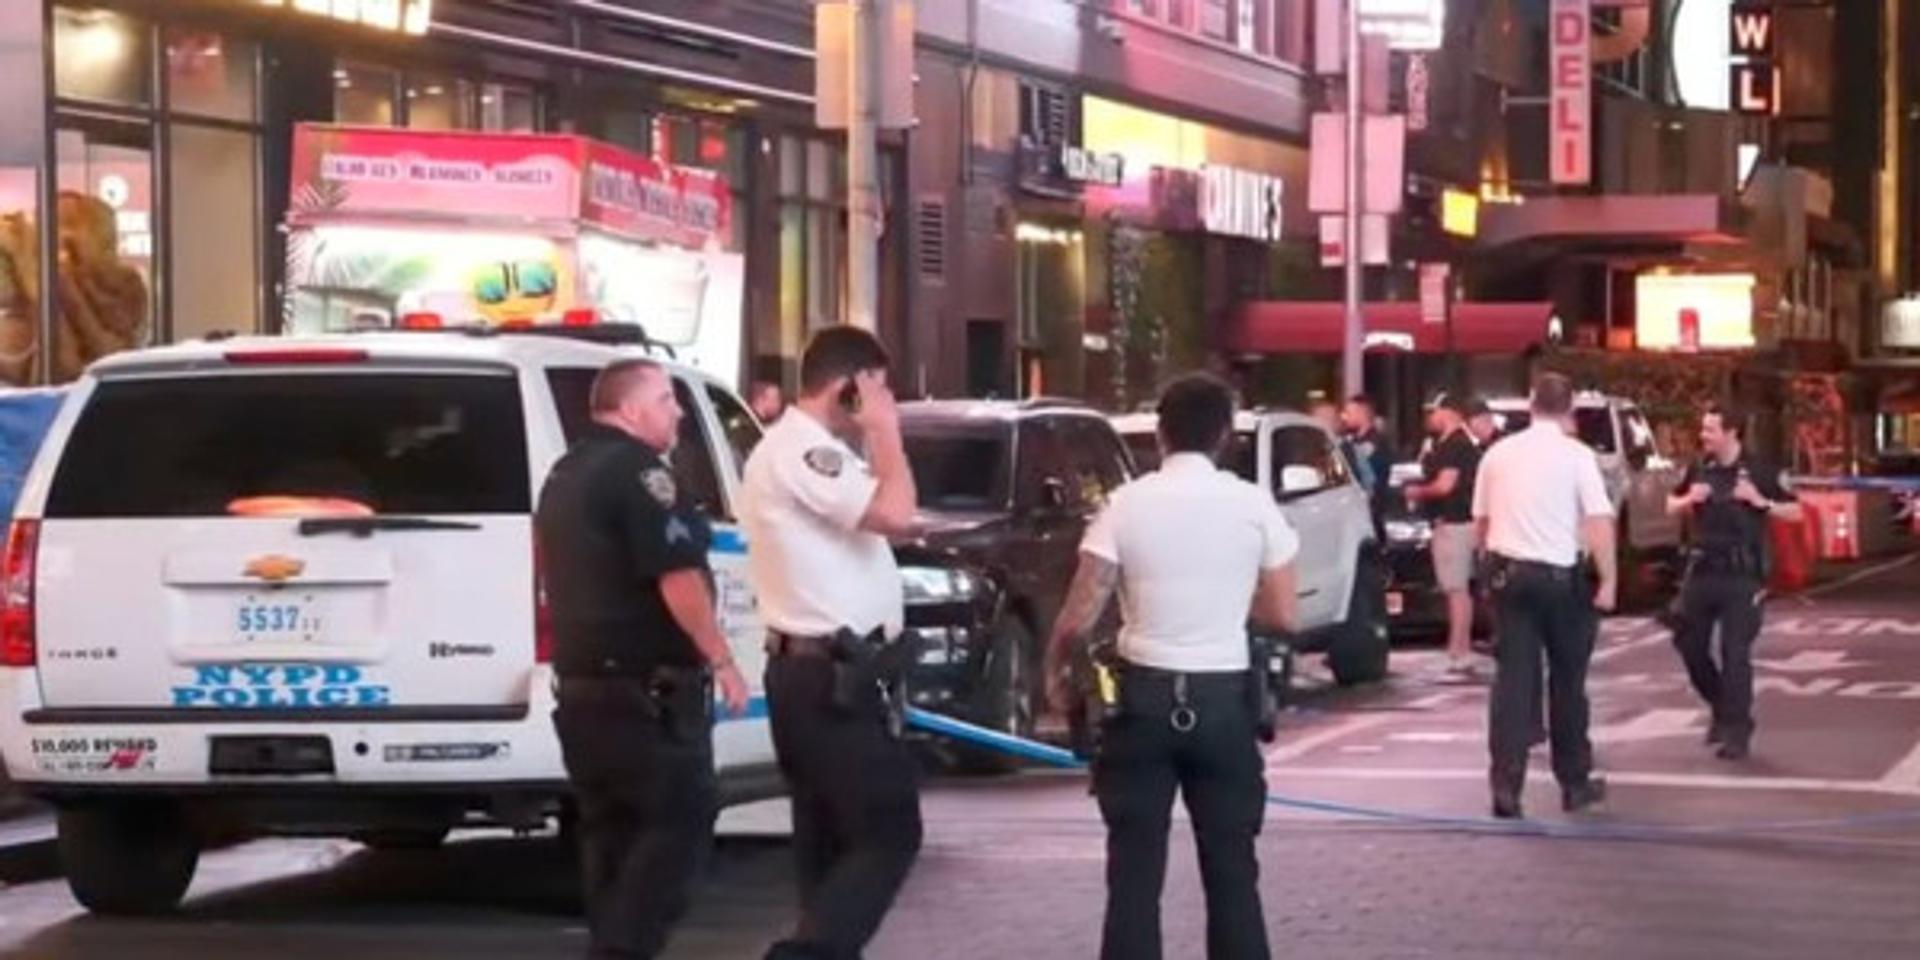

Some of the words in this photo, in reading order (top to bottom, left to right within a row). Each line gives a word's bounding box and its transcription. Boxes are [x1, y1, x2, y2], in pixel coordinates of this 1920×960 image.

[1555, 13, 1584, 174] DELI
[239, 606, 299, 632] 5537
[195, 663, 361, 686] NYPD
[171, 686, 390, 709] POLICE
